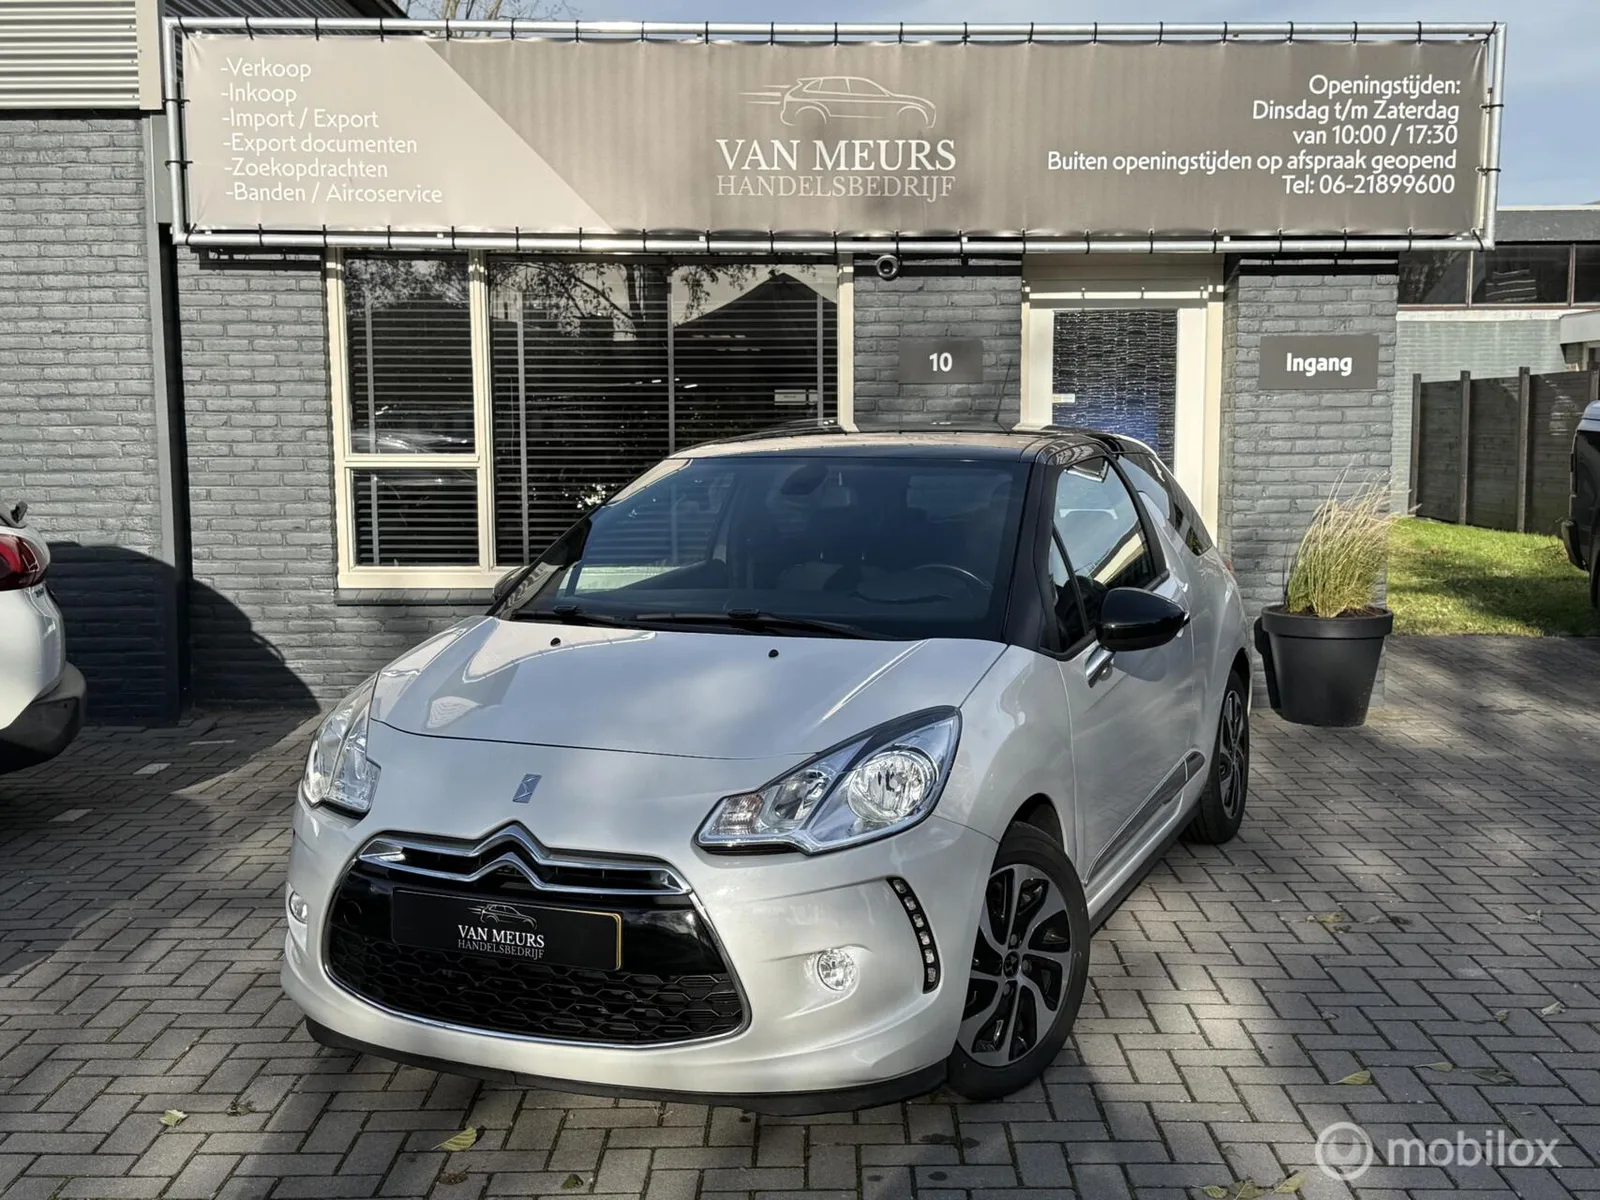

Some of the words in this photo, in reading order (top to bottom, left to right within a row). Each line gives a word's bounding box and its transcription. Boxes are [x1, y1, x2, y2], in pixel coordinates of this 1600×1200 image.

[220, 56, 311, 82] -Verkoop
[220, 81, 297, 107] -Inkoop
[1309, 74, 1461, 99] Openingstijden:
[221, 107, 295, 131] -Import
[299, 107, 308, 129] /
[314, 109, 379, 133] Export
[1253, 99, 1329, 124] Dinsdag
[1334, 99, 1368, 121] t/m
[1373, 99, 1460, 124] Zaterdag
[223, 132, 297, 156] -Export
[301, 133, 417, 153] documenten
[1293, 130, 1327, 144] van
[1332, 125, 1386, 145] 10:00
[1390, 124, 1402, 146] /
[1406, 125, 1458, 144] 17:30
[715, 139, 800, 171] VAN
[812, 139, 956, 171] MEURS
[1048, 151, 1107, 170] Buiten
[1112, 150, 1251, 175] openingstijden
[1257, 155, 1282, 174] op
[1287, 149, 1366, 174] afspraak
[1371, 149, 1457, 174] geopend
[224, 157, 388, 181] -Zoekopdrachten
[225, 182, 305, 201] -Banden
[311, 182, 320, 204] /
[326, 184, 443, 203] Aircoservice
[715, 175, 956, 203] HANDELSBEDRIJF
[1282, 174, 1315, 194] Tel:
[1319, 174, 1455, 194] 06-21899600
[929, 352, 953, 372] 10
[1286, 352, 1353, 377] Ingang
[458, 924, 488, 941] VAN
[492, 929, 545, 948] MEURS
[458, 939, 545, 960] HANDELSBEDRIJF
